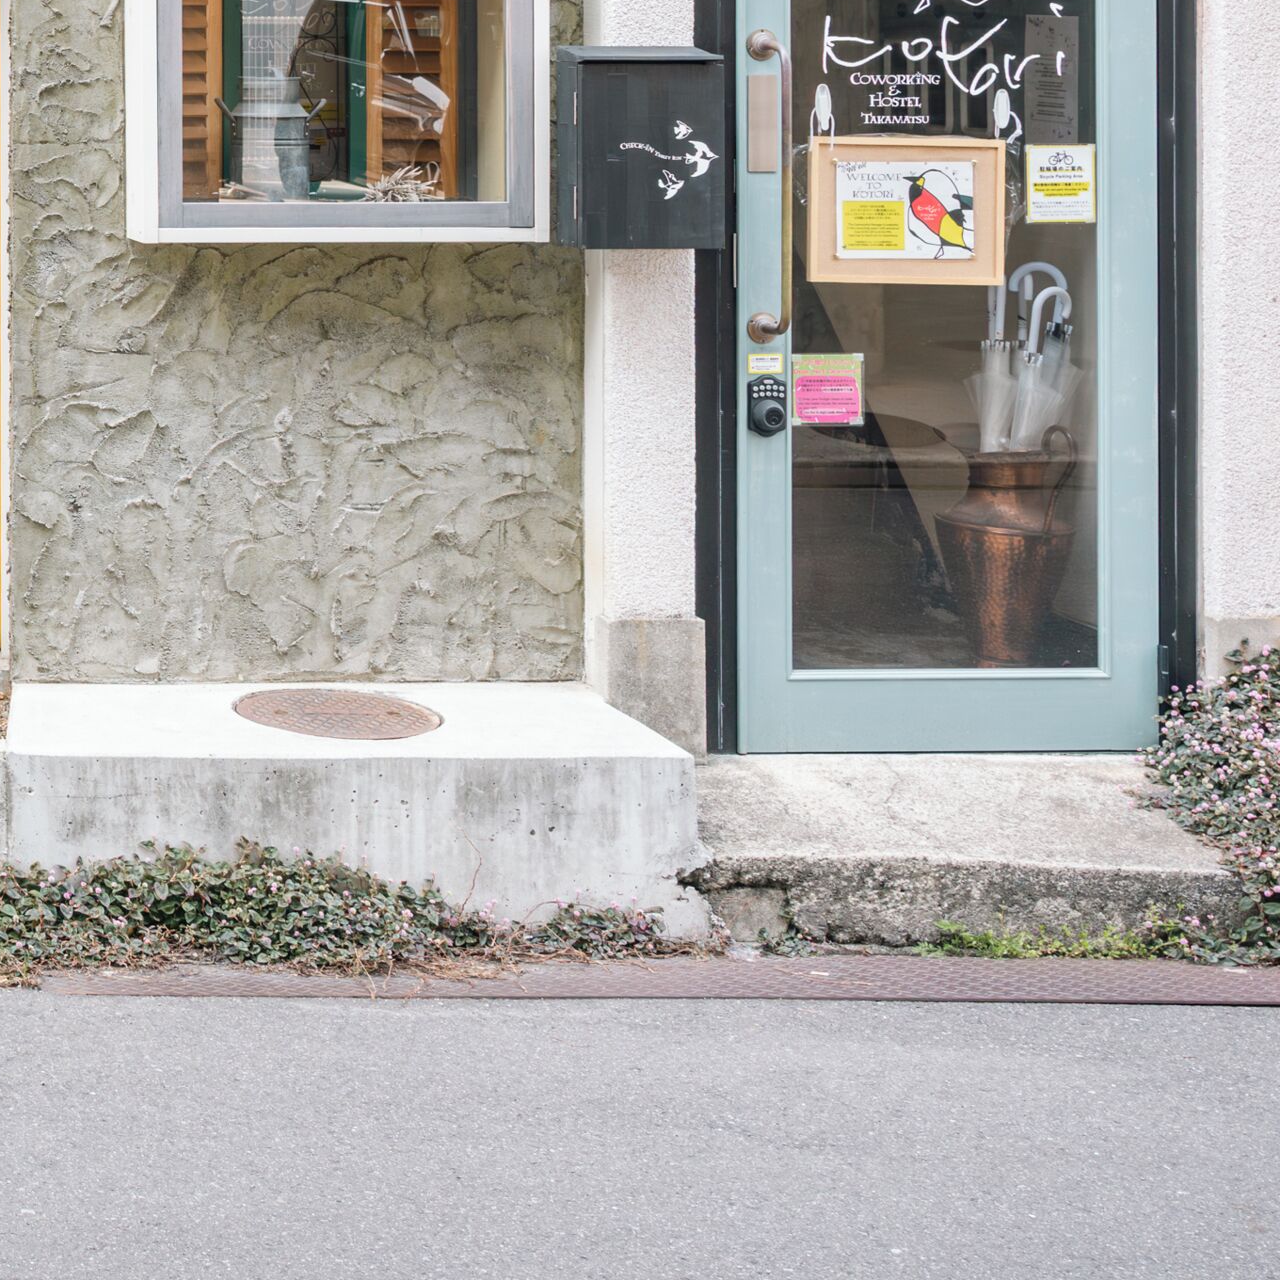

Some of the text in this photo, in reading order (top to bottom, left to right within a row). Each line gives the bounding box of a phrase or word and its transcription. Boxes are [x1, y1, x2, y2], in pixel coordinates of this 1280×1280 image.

[850, 71, 941, 86] COWORKING
[888, 86, 901, 96] &
[869, 92, 922, 109] HOSTEL
[861, 111, 930, 125] TAKAMATSU
[847, 173, 902, 181] WELCOME
[867, 182, 882, 190] TO
